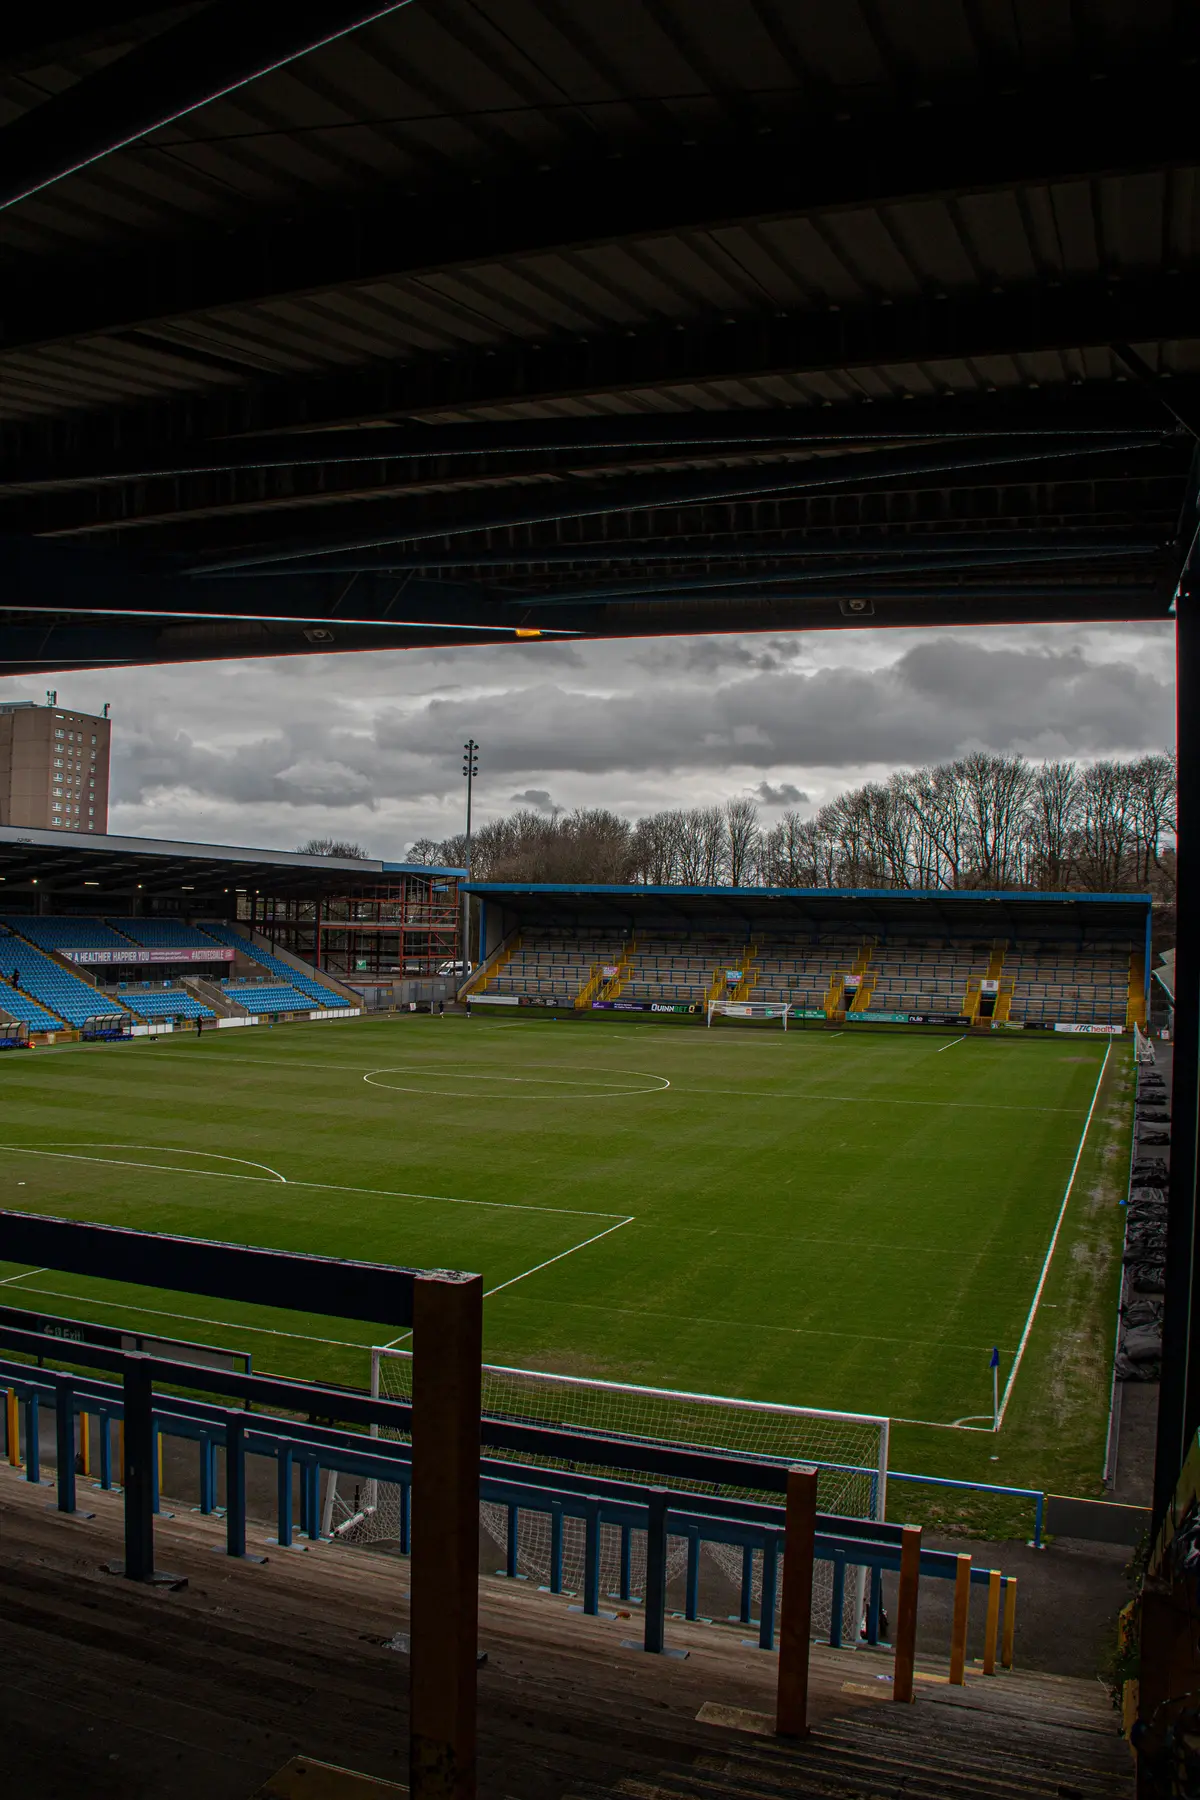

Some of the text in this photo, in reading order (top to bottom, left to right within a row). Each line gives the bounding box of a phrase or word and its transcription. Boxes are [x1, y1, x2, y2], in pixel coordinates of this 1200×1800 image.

[74, 952, 80, 962] A
[80, 952, 111, 962] HEALTHIER
[113, 952, 137, 962] HAPPIER
[138, 952, 150, 961] YOU
